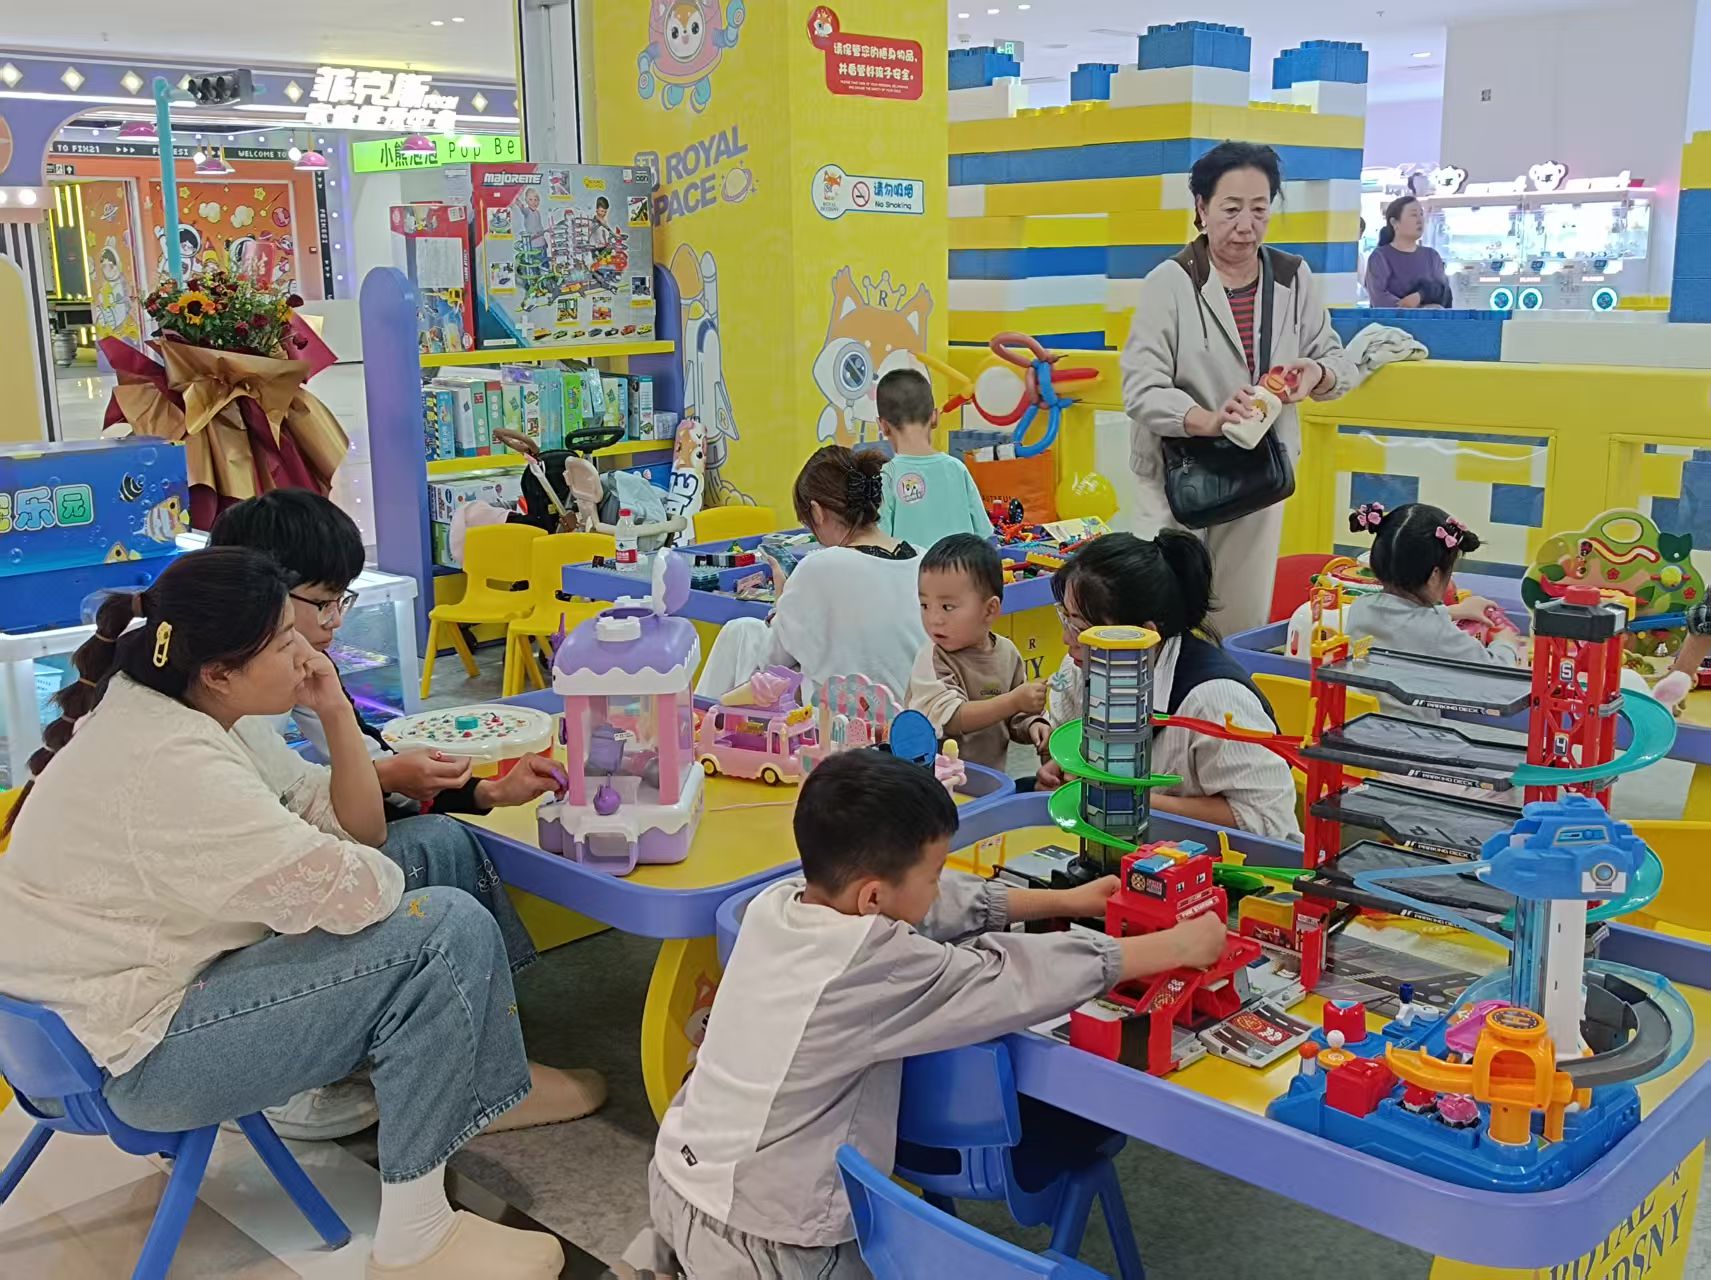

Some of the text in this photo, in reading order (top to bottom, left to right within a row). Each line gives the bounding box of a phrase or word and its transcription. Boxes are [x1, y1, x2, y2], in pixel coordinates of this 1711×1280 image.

[238, 150, 287, 158] WELCOME TO
[665, 124, 749, 185] ROYAL
[652, 173, 717, 227] PACE
[878, 290, 888, 307] R
[1028, 638, 1036, 650] R
[1426, 702, 1479, 714] PARKING DECK
[1556, 737, 1567, 753] 4
[1422, 773, 1453, 783] PARKING
[1418, 843, 1449, 854] PARKING
